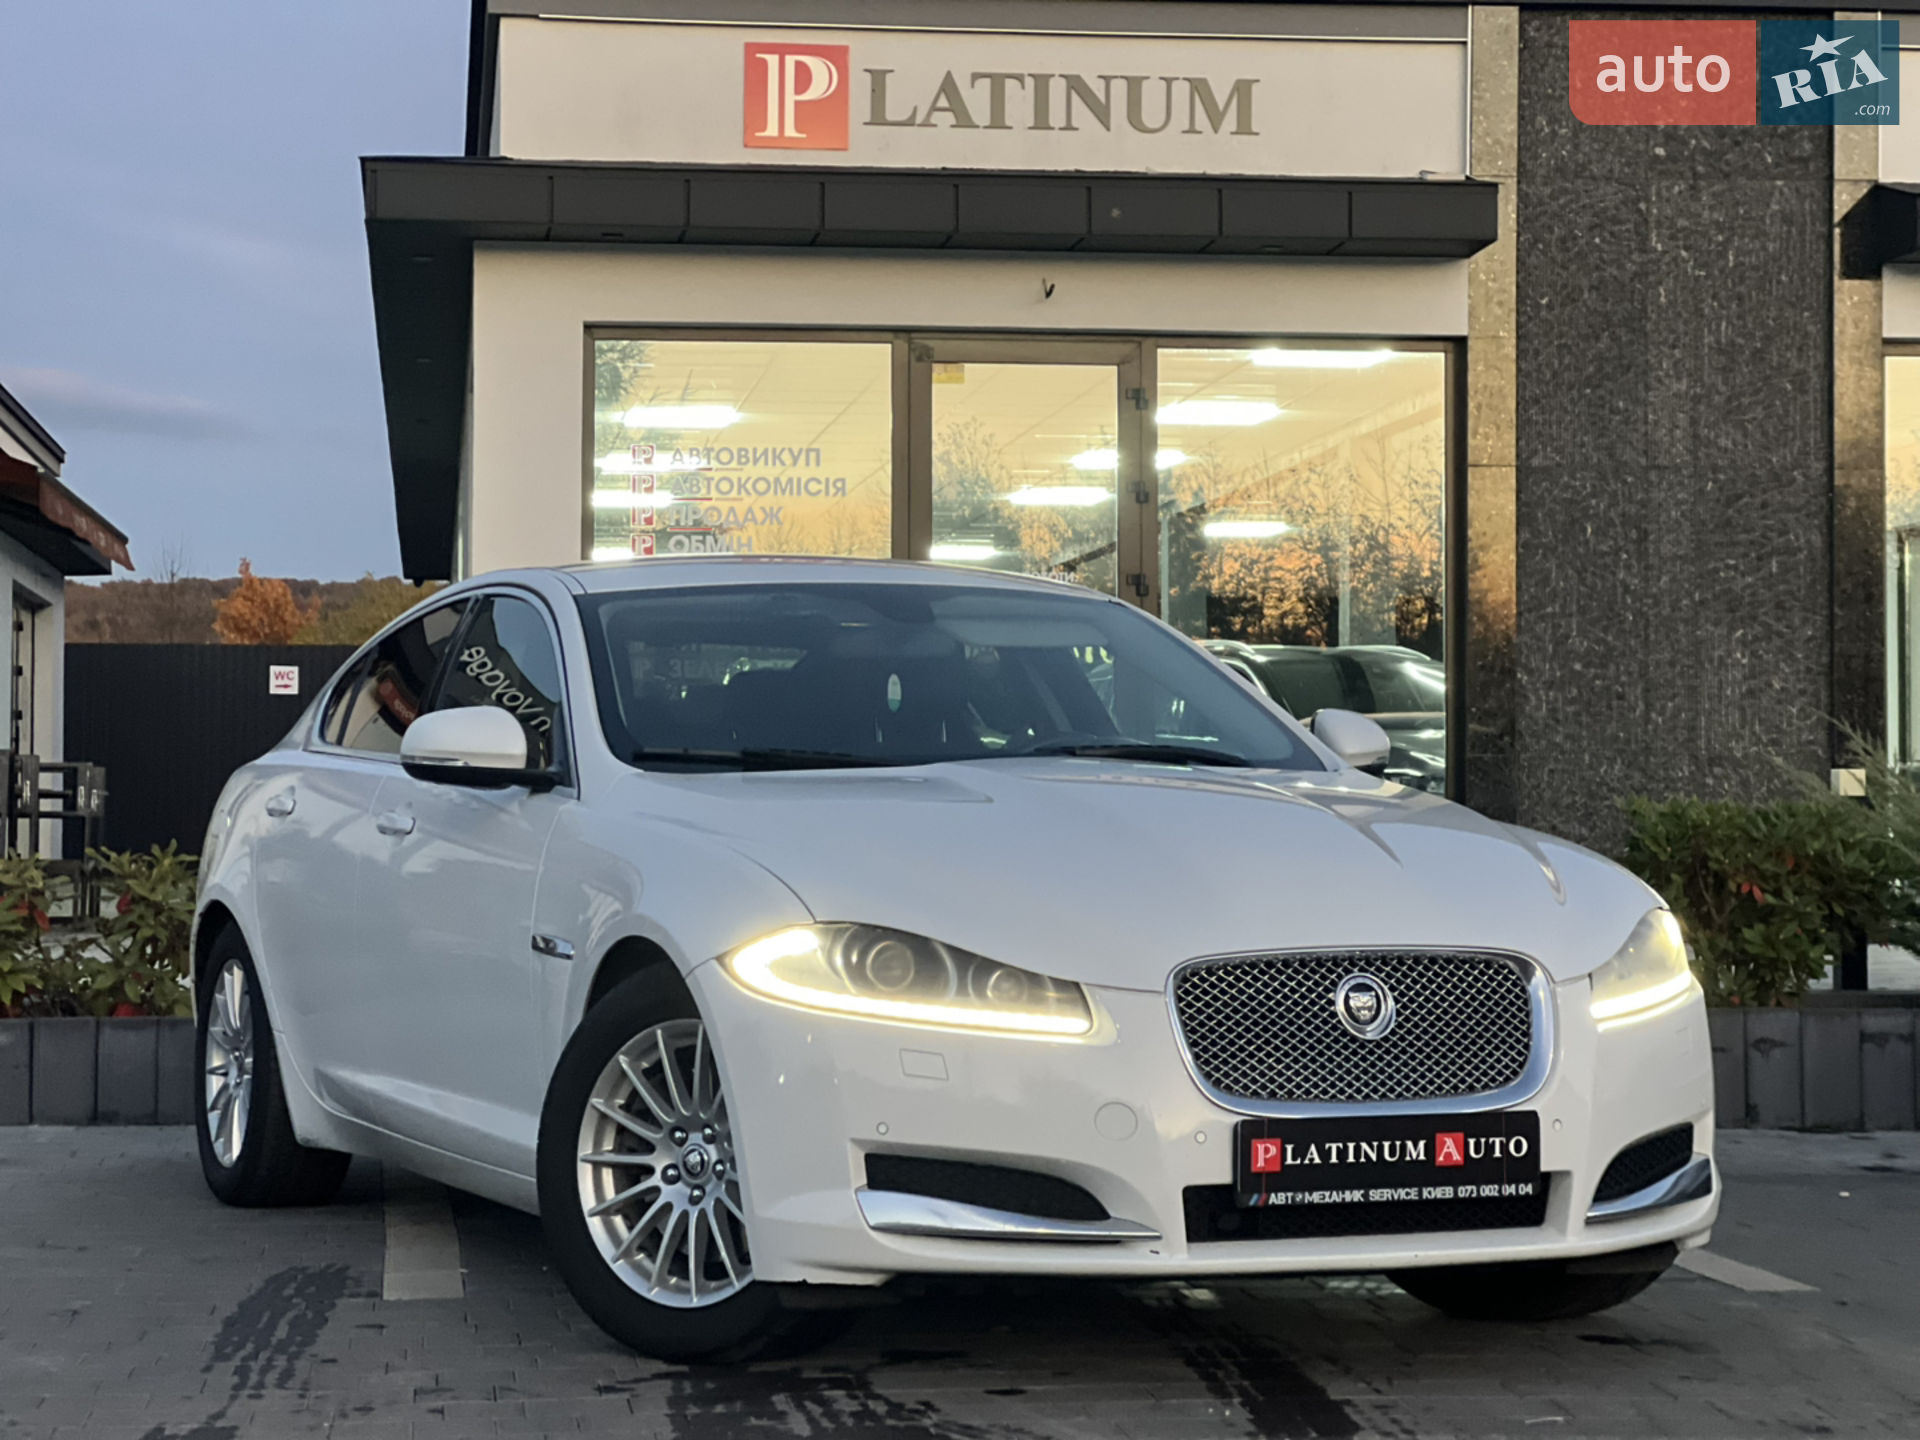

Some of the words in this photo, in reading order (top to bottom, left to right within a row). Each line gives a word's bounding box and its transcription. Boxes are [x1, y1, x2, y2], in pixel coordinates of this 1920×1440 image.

[670, 447, 822, 467] АВТОВИКУП
[670, 475, 847, 497] АВТОКОМІСІЯ
[668, 506, 784, 528] ПРОДАЖ
[273, 670, 295, 681] WC
[1369, 1188, 1419, 1201] SERVICE
[1457, 1185, 1477, 1198] 073
[1480, 1185, 1499, 1197] 002
[1501, 1184, 1516, 1196] 04
[1518, 1183, 1533, 1195] 04
